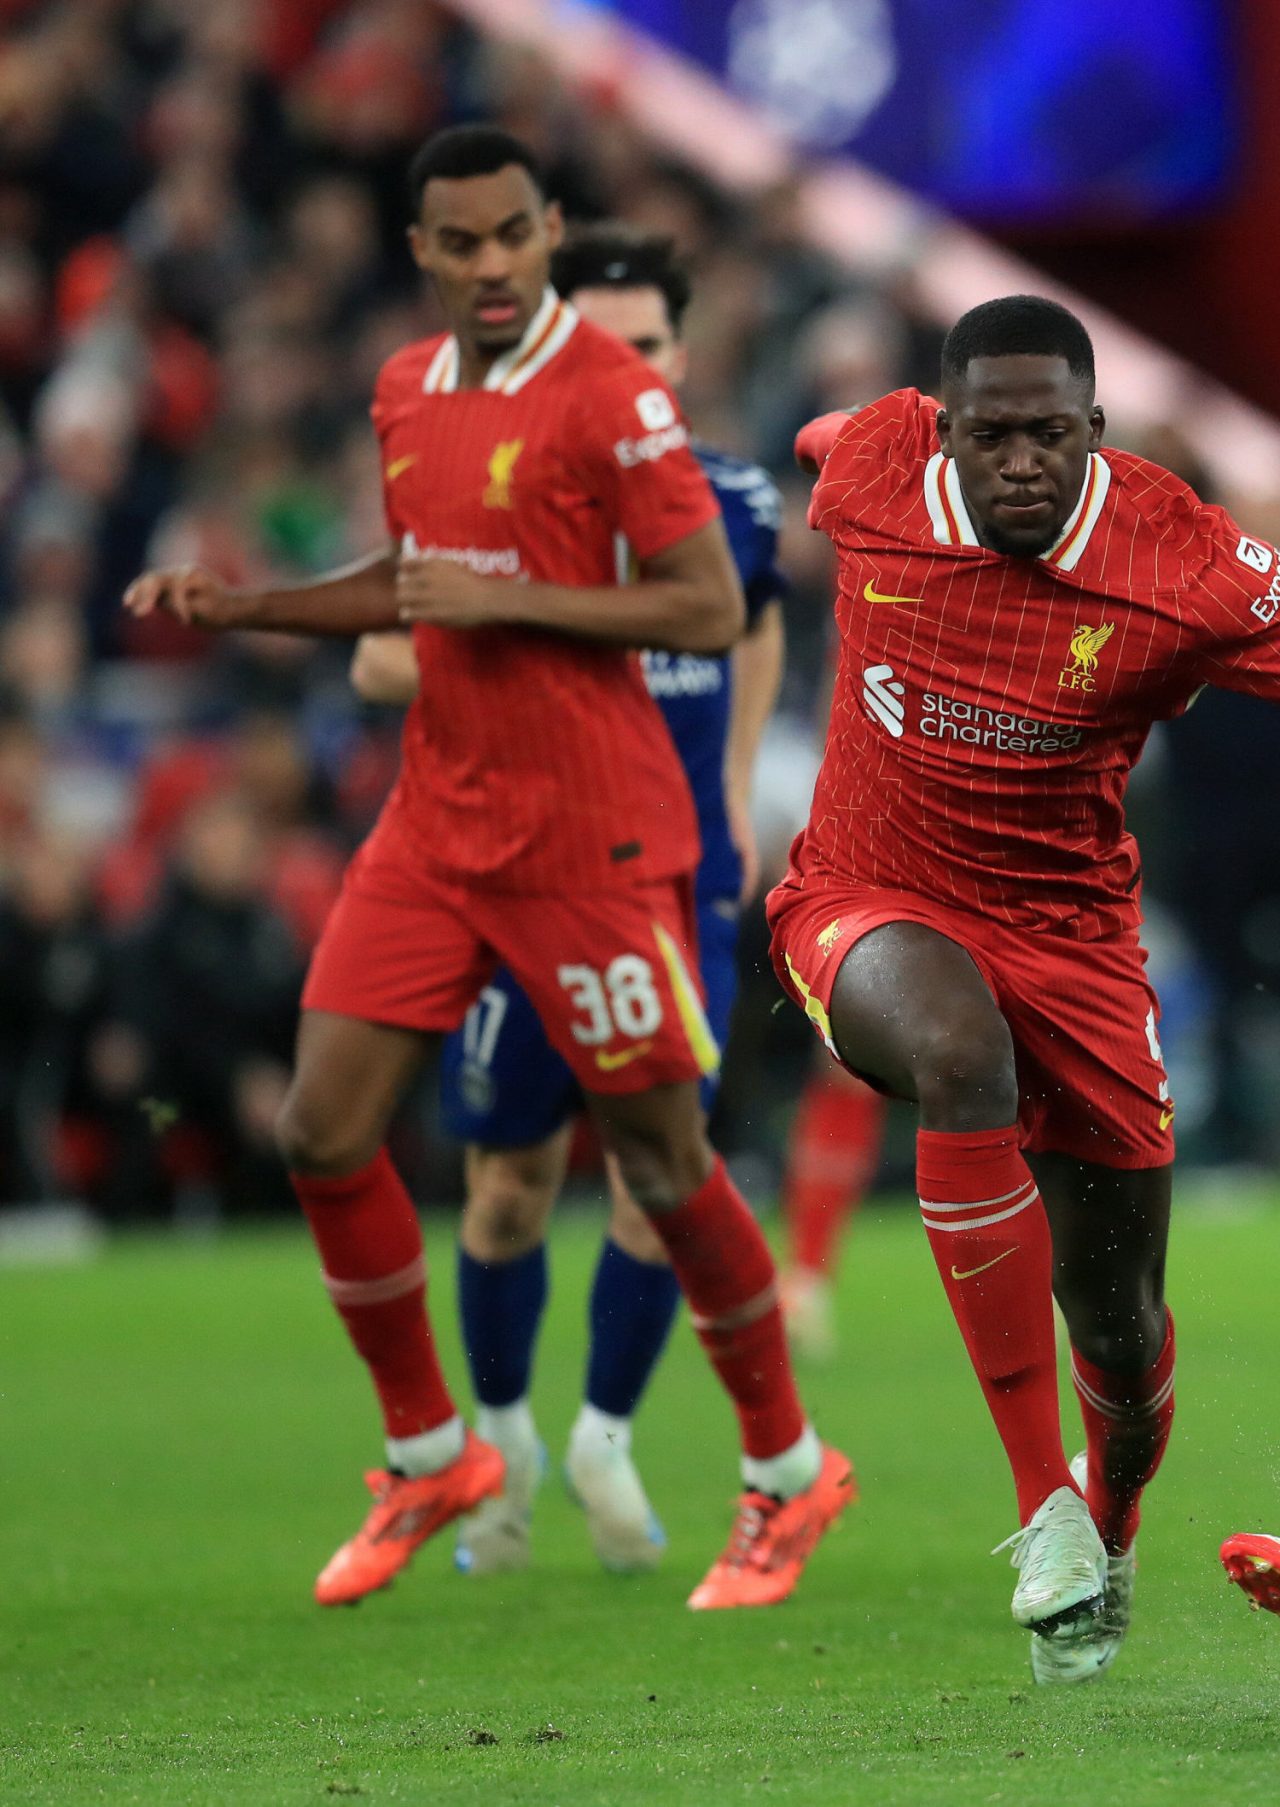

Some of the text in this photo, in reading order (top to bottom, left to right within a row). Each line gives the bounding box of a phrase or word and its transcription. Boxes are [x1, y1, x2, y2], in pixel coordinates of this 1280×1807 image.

[1057, 671, 1097, 692] L.F.C.
[919, 716, 1082, 753] chartered
[557, 954, 663, 1045] 38
